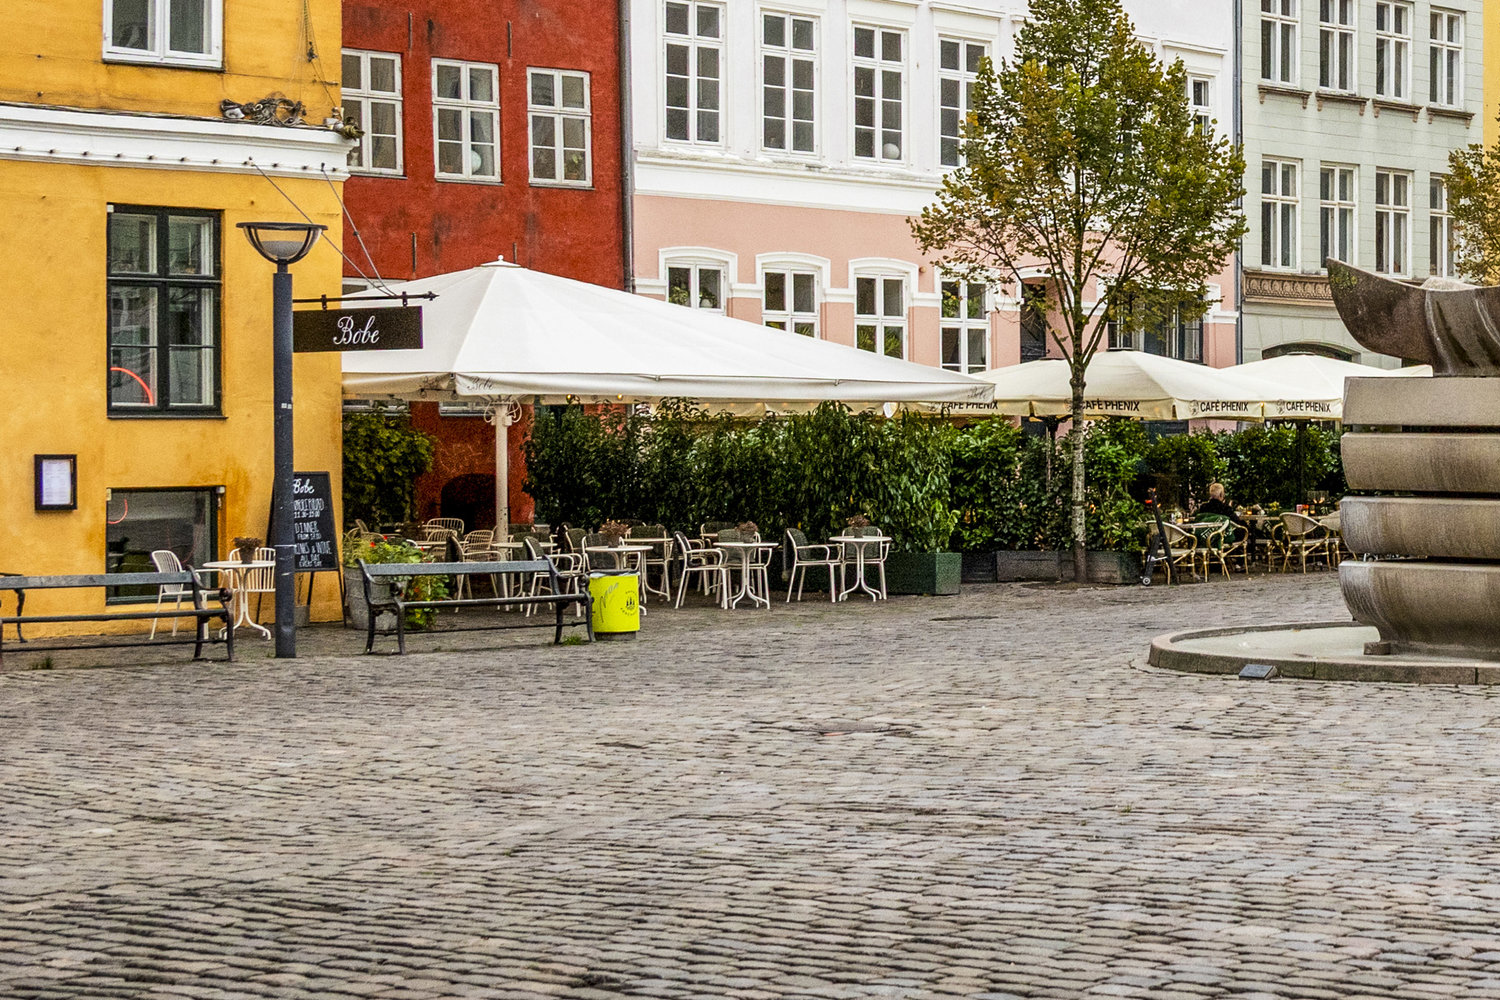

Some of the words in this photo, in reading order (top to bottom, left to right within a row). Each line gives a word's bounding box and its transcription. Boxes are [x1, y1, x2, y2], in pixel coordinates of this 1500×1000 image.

[333, 315, 379, 344] Bobe
[1105, 400, 1140, 411] PHENIX
[1200, 399, 1220, 412] CAFÉ
[1221, 401, 1248, 412] PHENIX
[1286, 399, 1304, 411] CAFÉ
[1305, 401, 1331, 413] PHENIX
